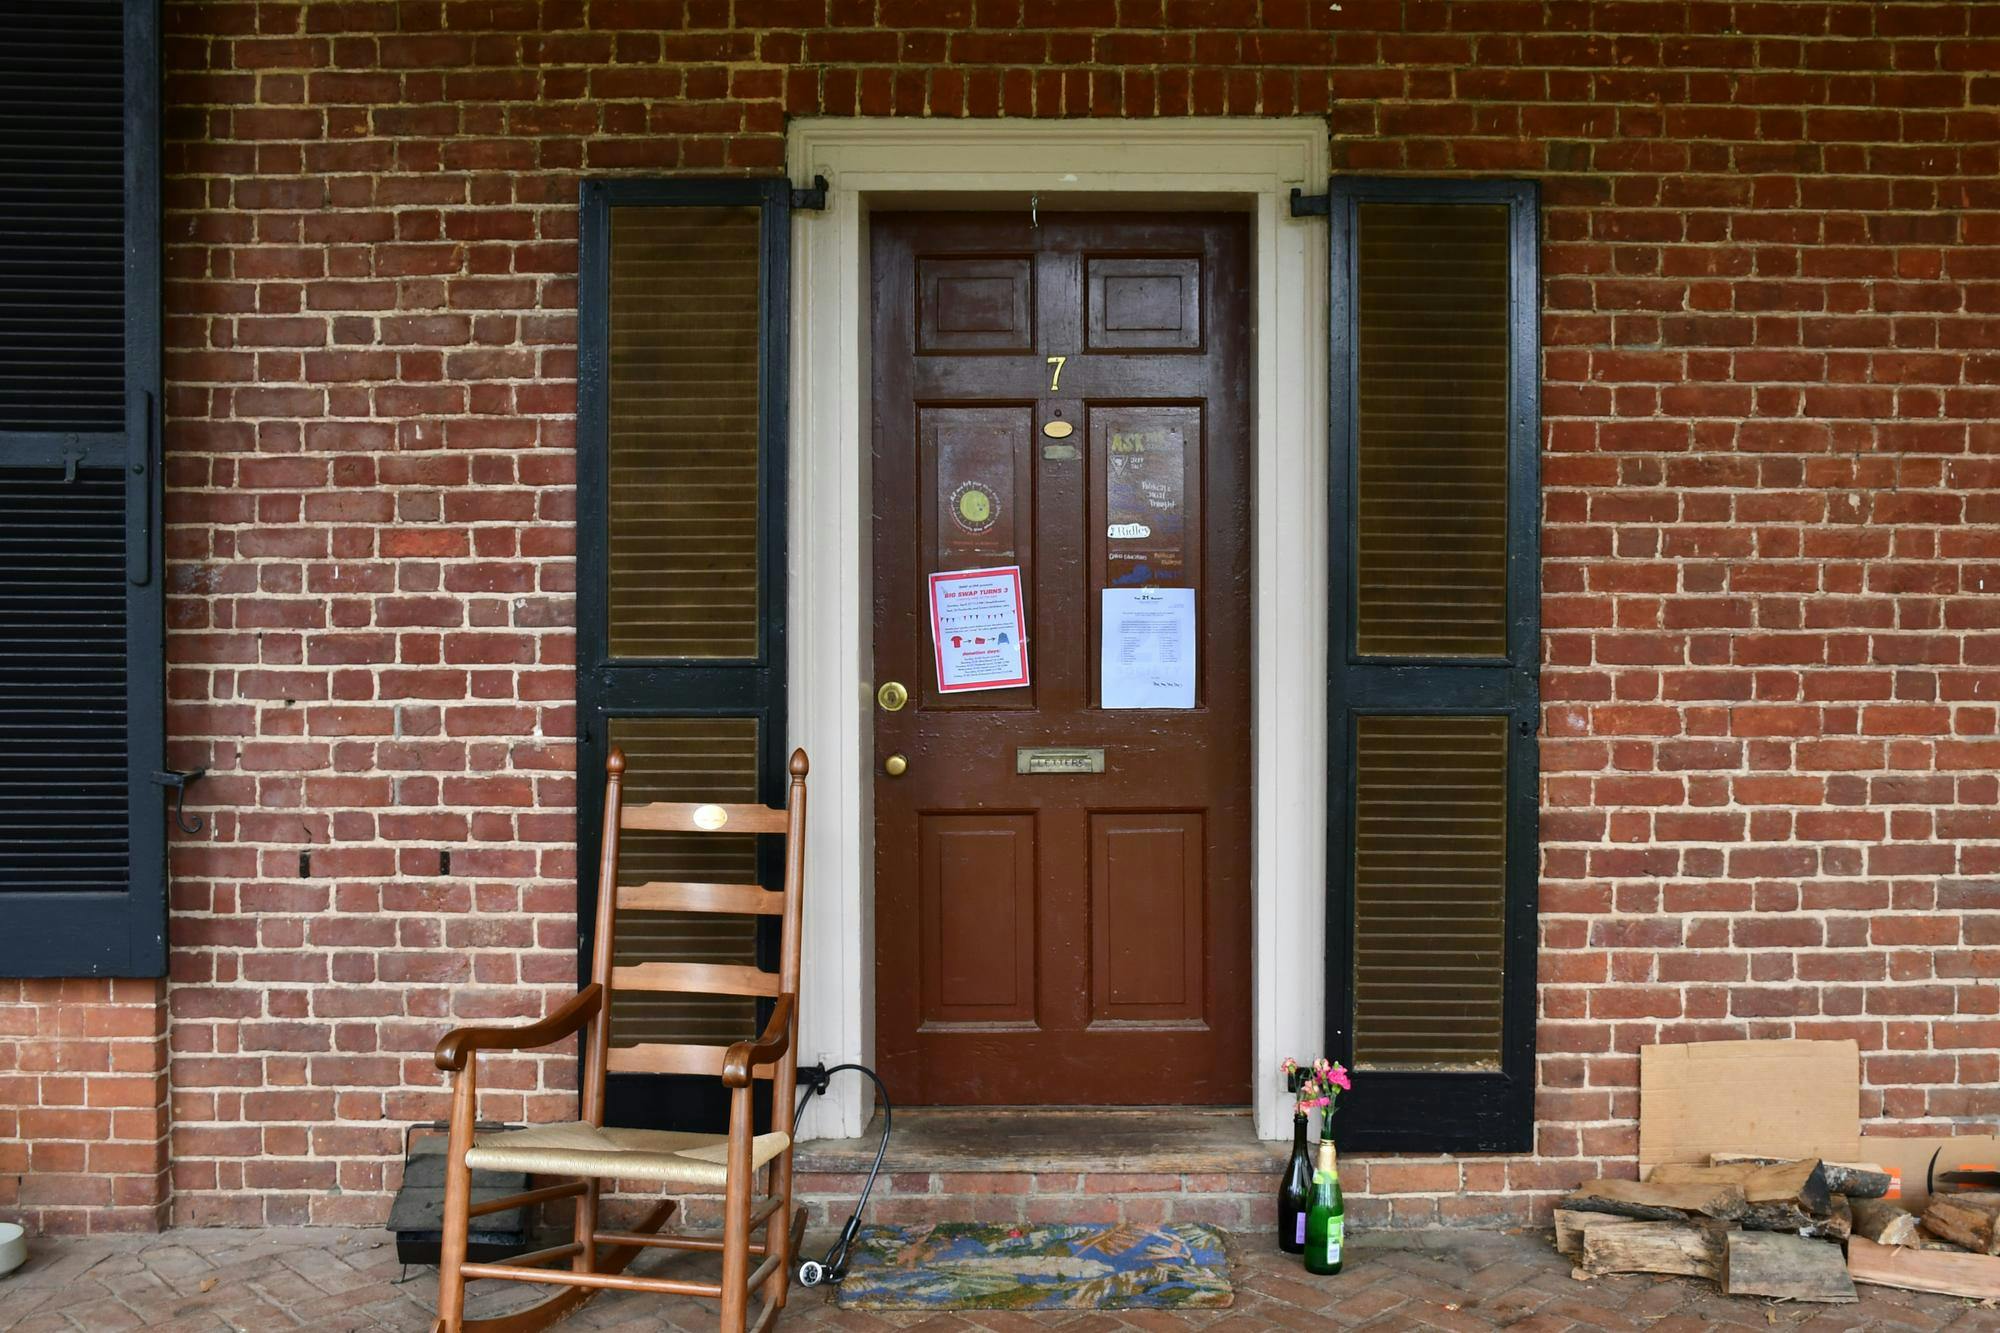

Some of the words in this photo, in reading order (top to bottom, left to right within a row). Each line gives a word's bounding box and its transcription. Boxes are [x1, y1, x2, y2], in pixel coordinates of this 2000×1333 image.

[1047, 356, 1067, 391] 7
[980, 588, 1002, 596] TURNS
[1037, 759, 1084, 768] LETTERS
